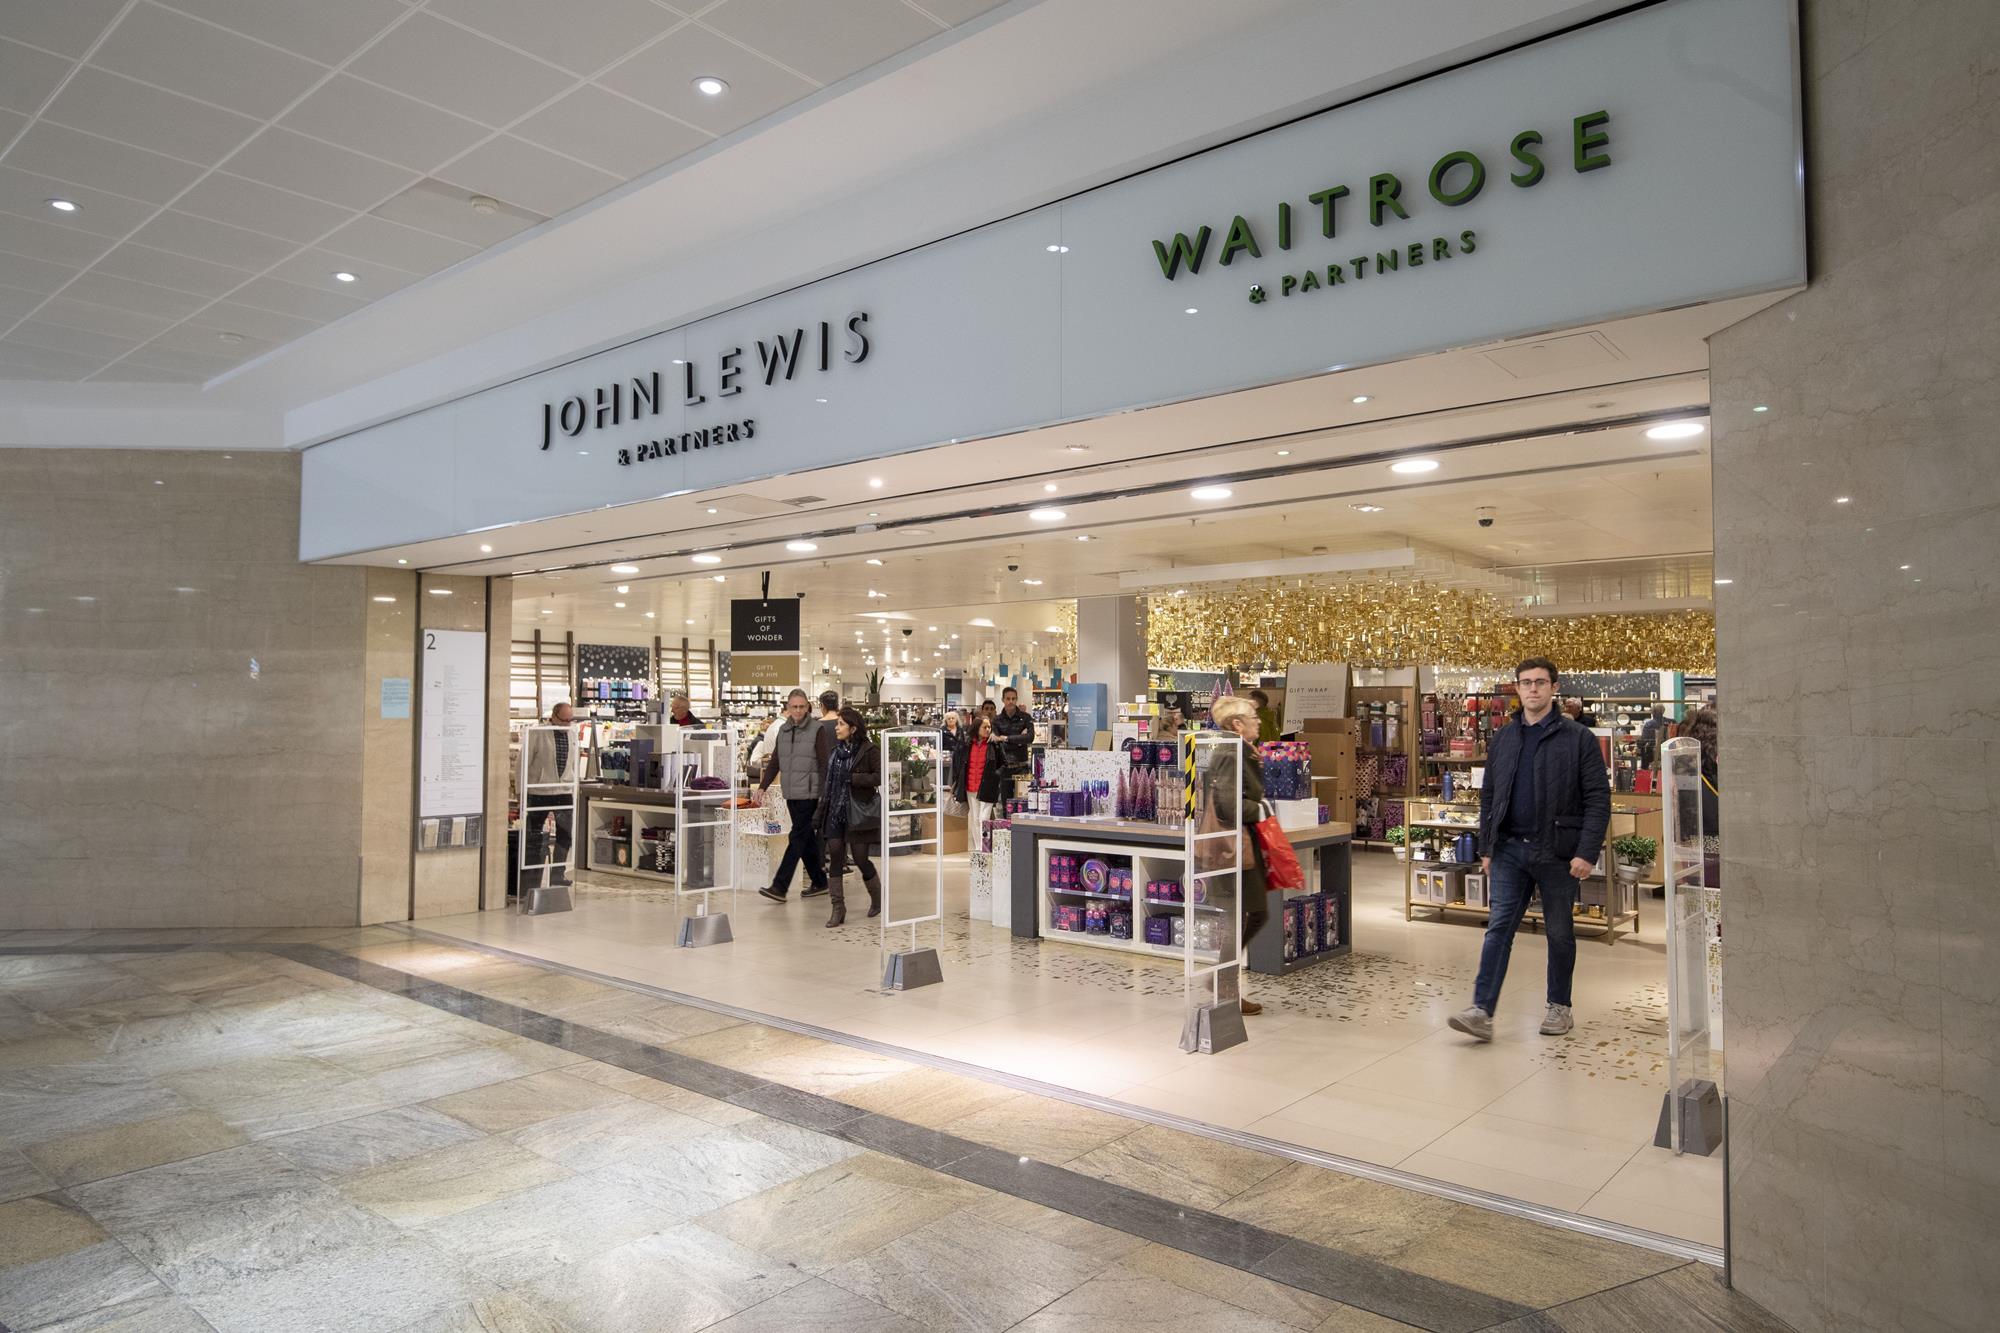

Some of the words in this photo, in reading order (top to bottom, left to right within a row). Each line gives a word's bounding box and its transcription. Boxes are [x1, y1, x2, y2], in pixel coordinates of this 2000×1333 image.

[1151, 109, 1612, 281] WAITROSE
[1248, 284, 1266, 304] &
[1281, 230, 1477, 297] PARTNERS
[538, 371, 660, 451] JOHN
[683, 311, 870, 407] LEWIS
[617, 448, 631, 466] &
[636, 419, 755, 463] PARTNERS
[426, 633, 436, 650] 2
[754, 615, 776, 623] GIFTS
